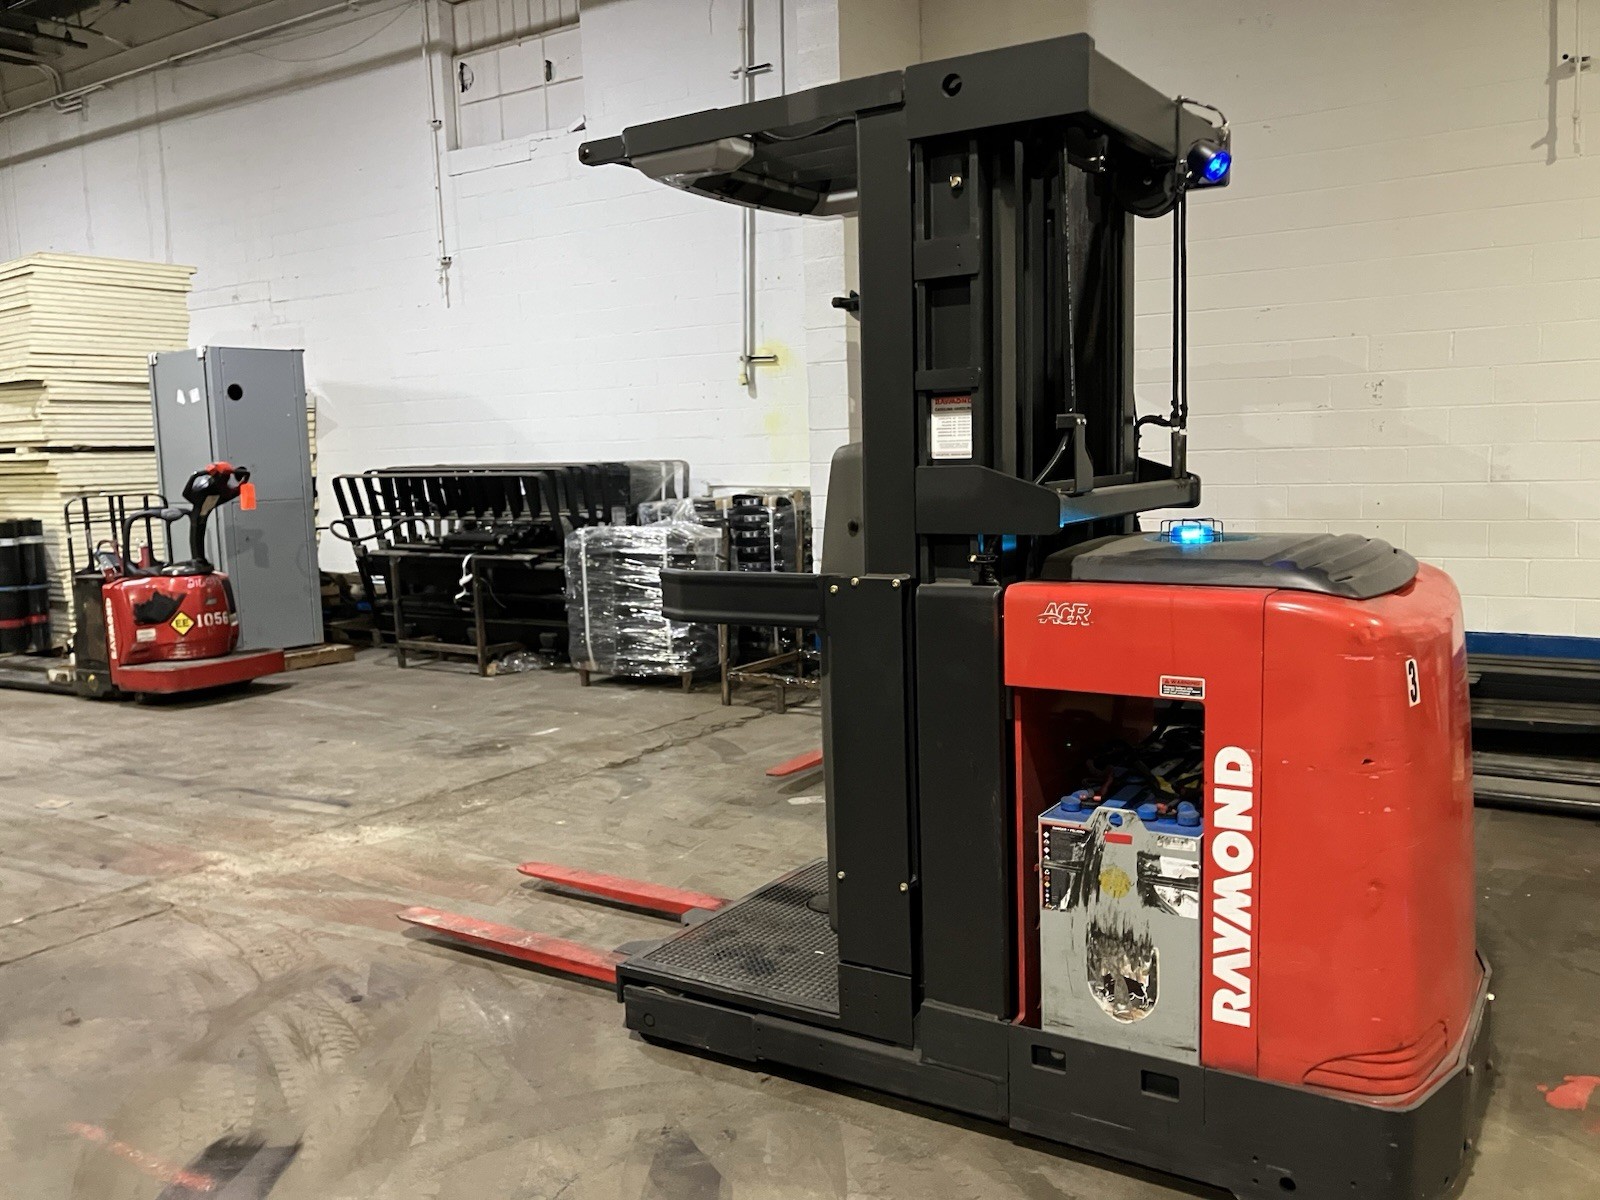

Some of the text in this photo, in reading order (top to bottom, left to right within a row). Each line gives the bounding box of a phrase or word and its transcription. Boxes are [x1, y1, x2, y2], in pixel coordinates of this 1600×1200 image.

[175, 618, 190, 628] EE
[196, 611, 229, 628] 1056
[1036, 602, 1092, 626] ACR
[1408, 660, 1418, 703] 3
[1211, 745, 1254, 1028] RAYMOND
